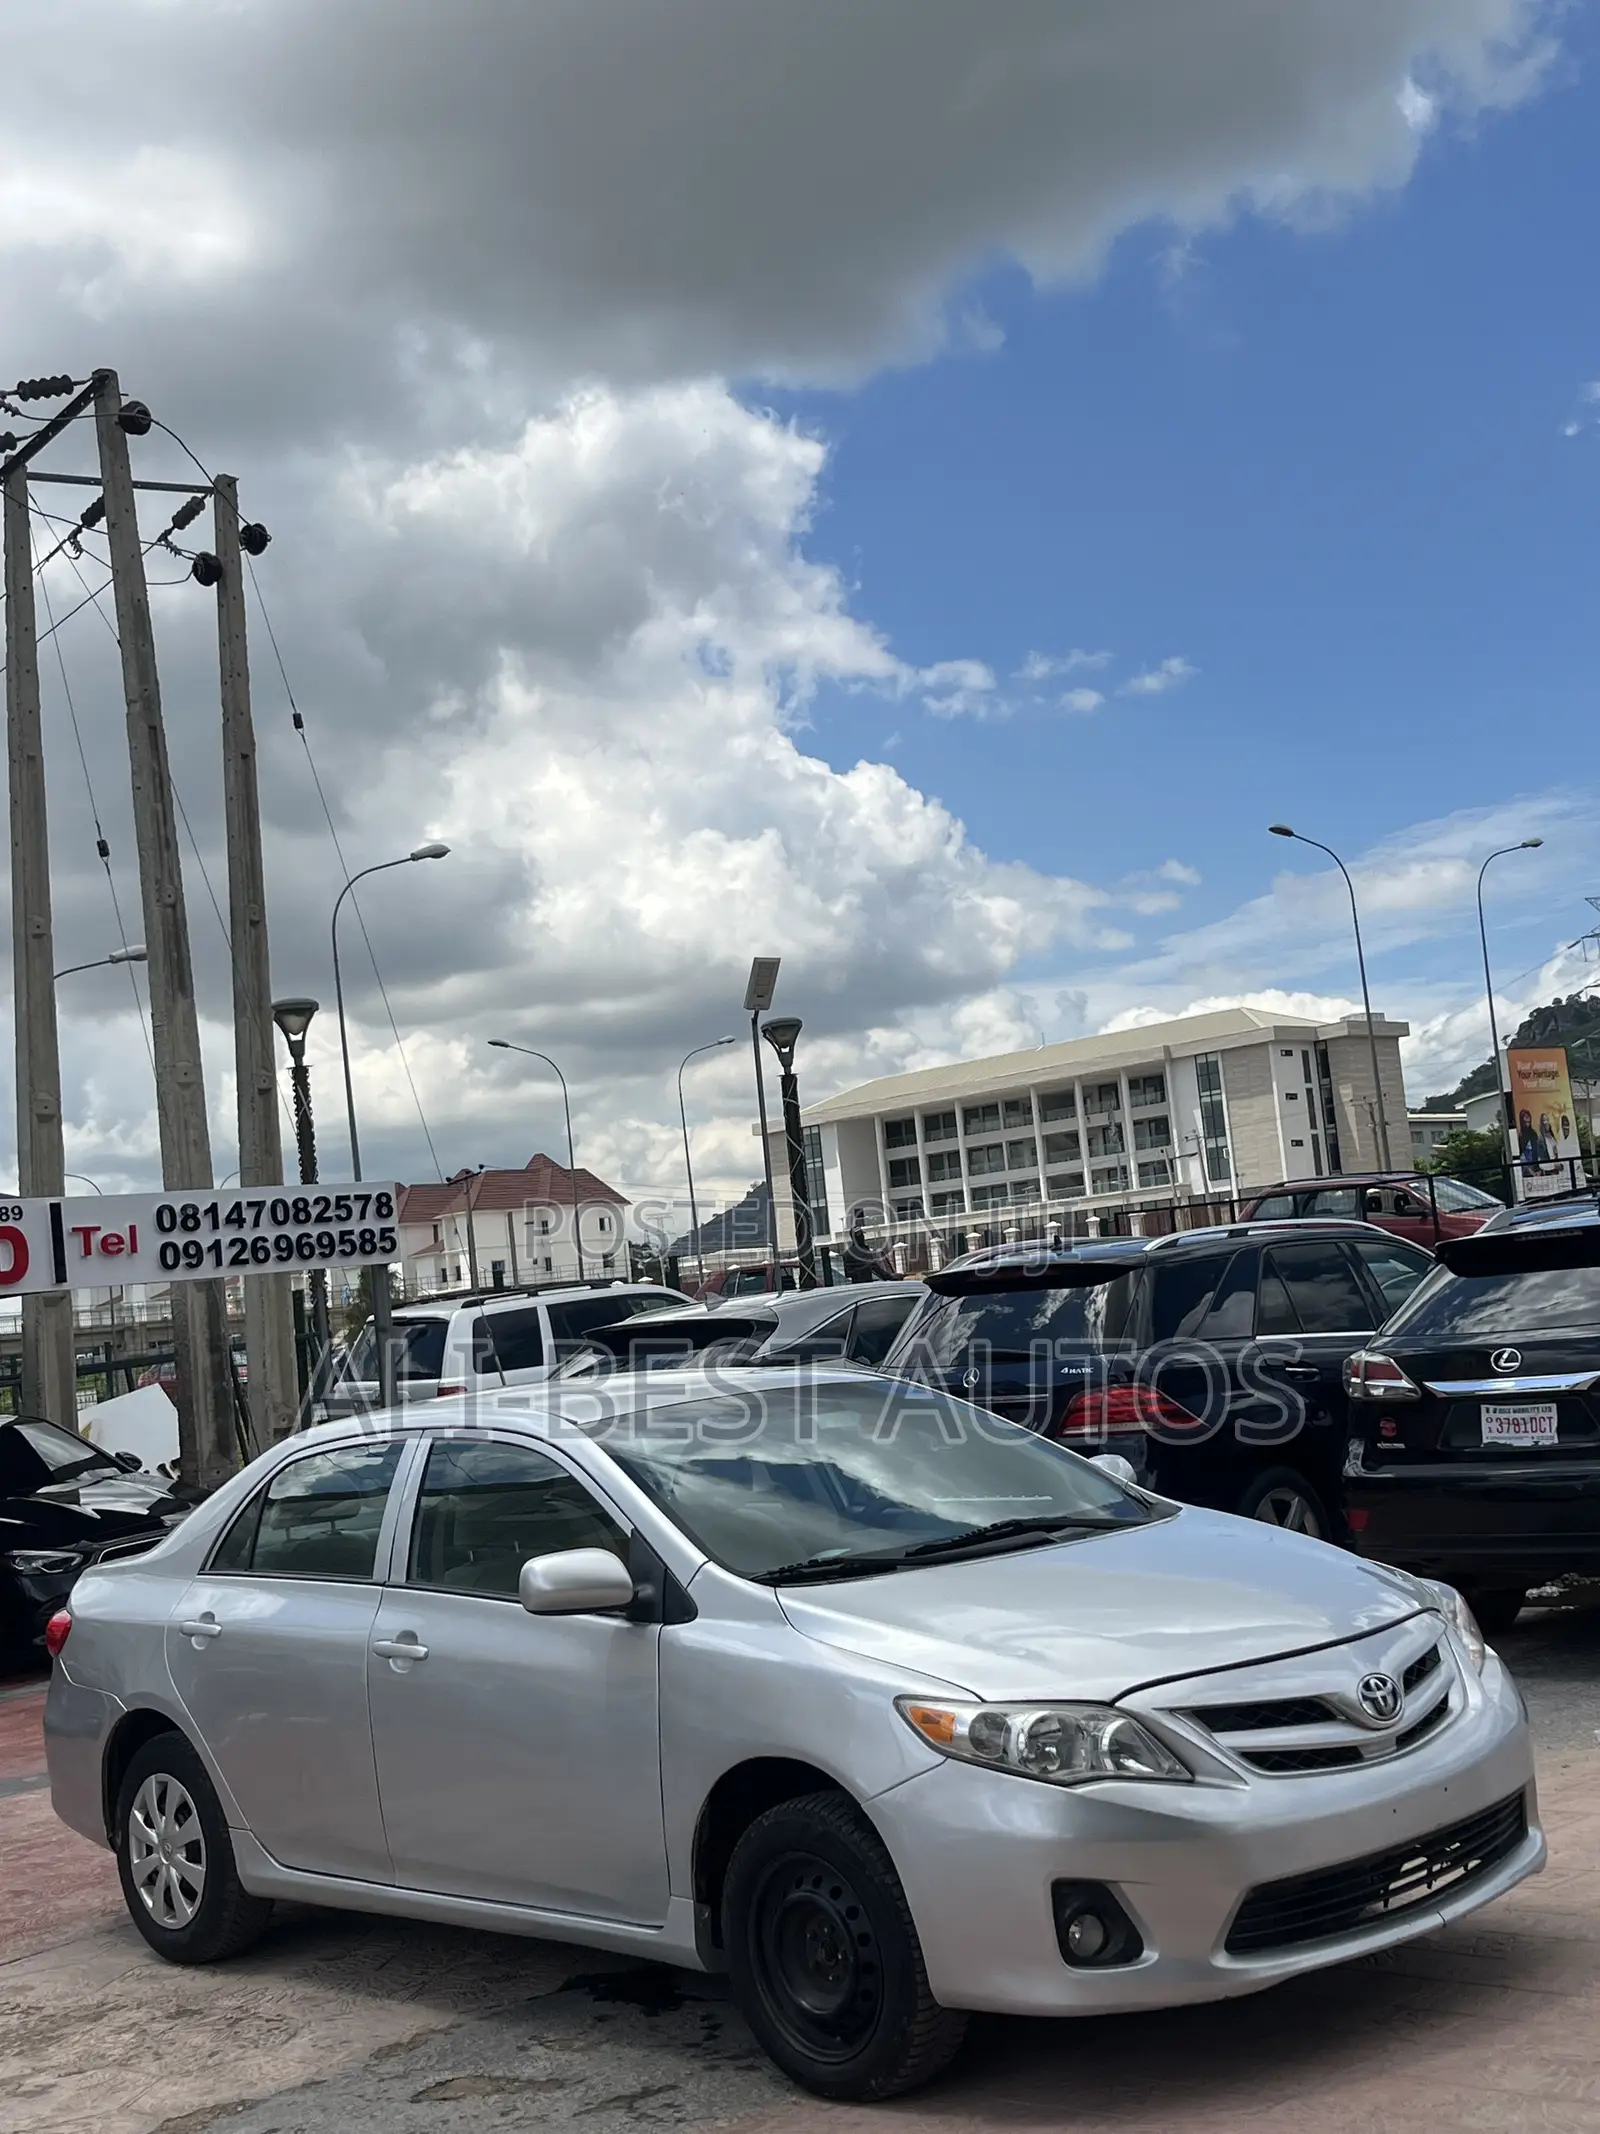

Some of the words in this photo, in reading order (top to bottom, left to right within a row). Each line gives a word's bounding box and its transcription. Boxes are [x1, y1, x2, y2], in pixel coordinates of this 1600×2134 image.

[155, 1192, 394, 1233] 08147082578
[72, 1225, 138, 1256] Tel
[159, 1227, 397, 1270] 09126969585
[1060, 1366, 1095, 1374] 4MATIC
[1495, 1416, 1554, 1434] 3781DCT
